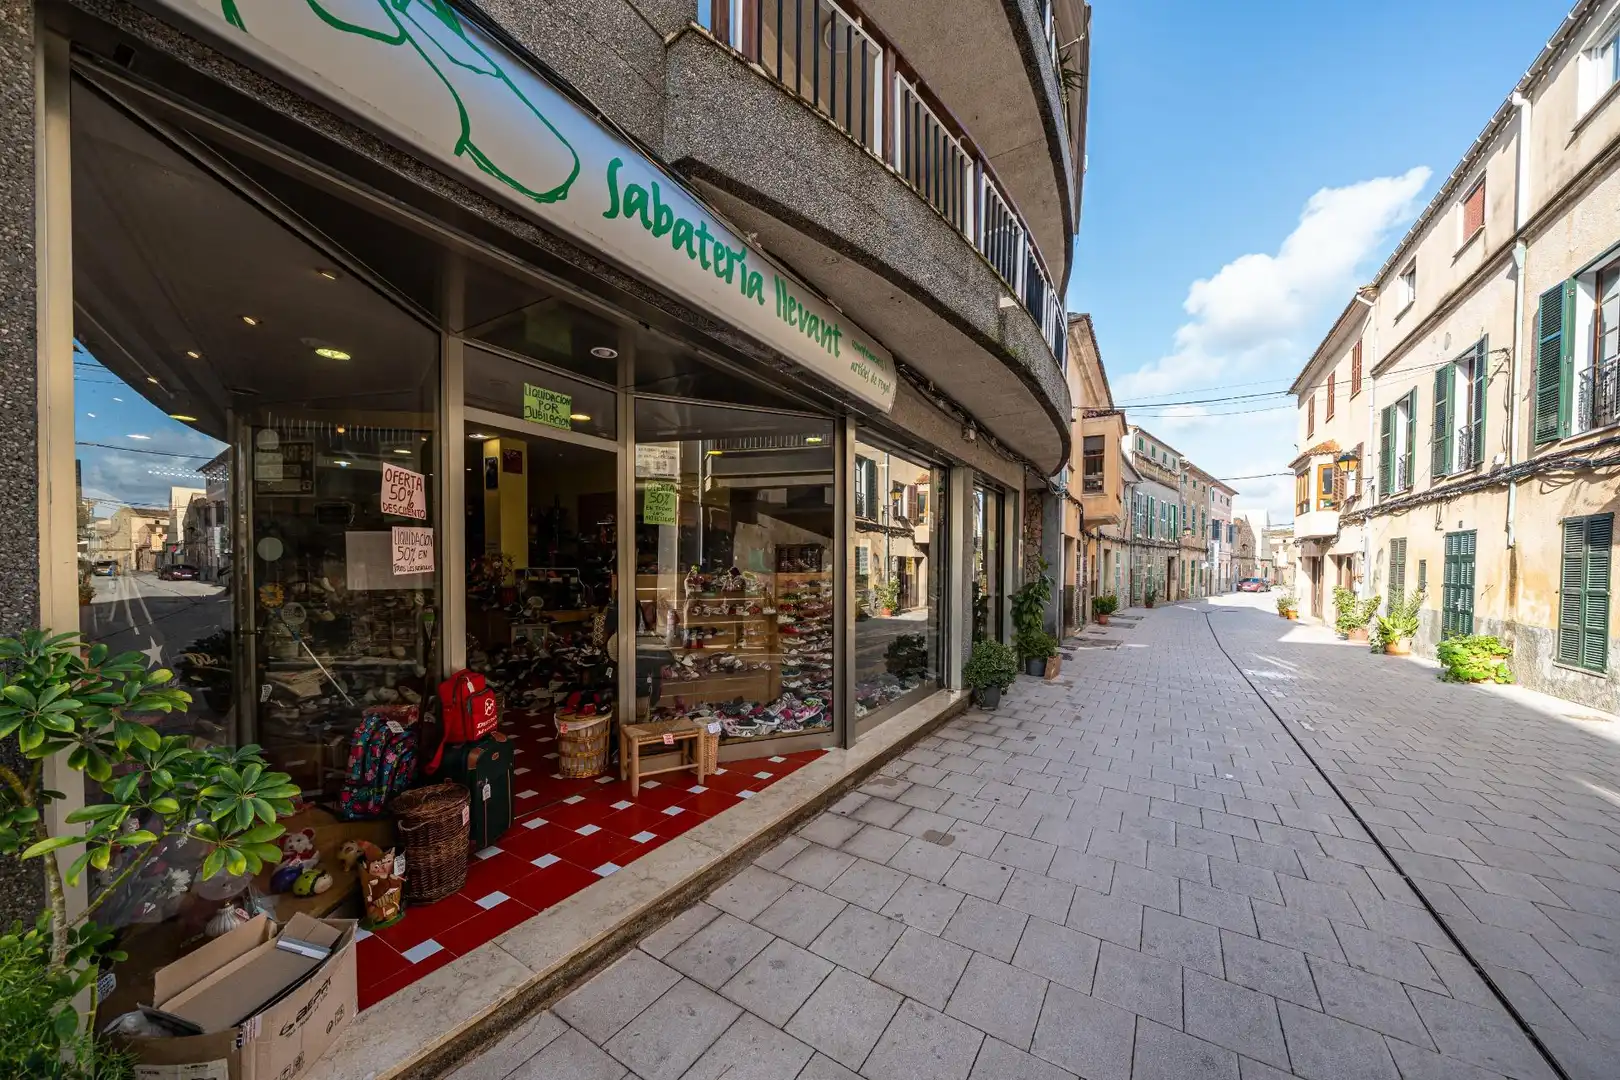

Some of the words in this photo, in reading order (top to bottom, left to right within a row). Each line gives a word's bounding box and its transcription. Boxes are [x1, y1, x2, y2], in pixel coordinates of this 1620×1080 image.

[774, 274, 842, 358] llevant
[538, 400, 560, 414] POR
[385, 468, 422, 492] OFERTA
[388, 484, 415, 510] 50%
[648, 492, 670, 506] 50%
[382, 501, 425, 518] DESCUENTO
[395, 545, 416, 565] 50%
[417, 549, 428, 560] EN
